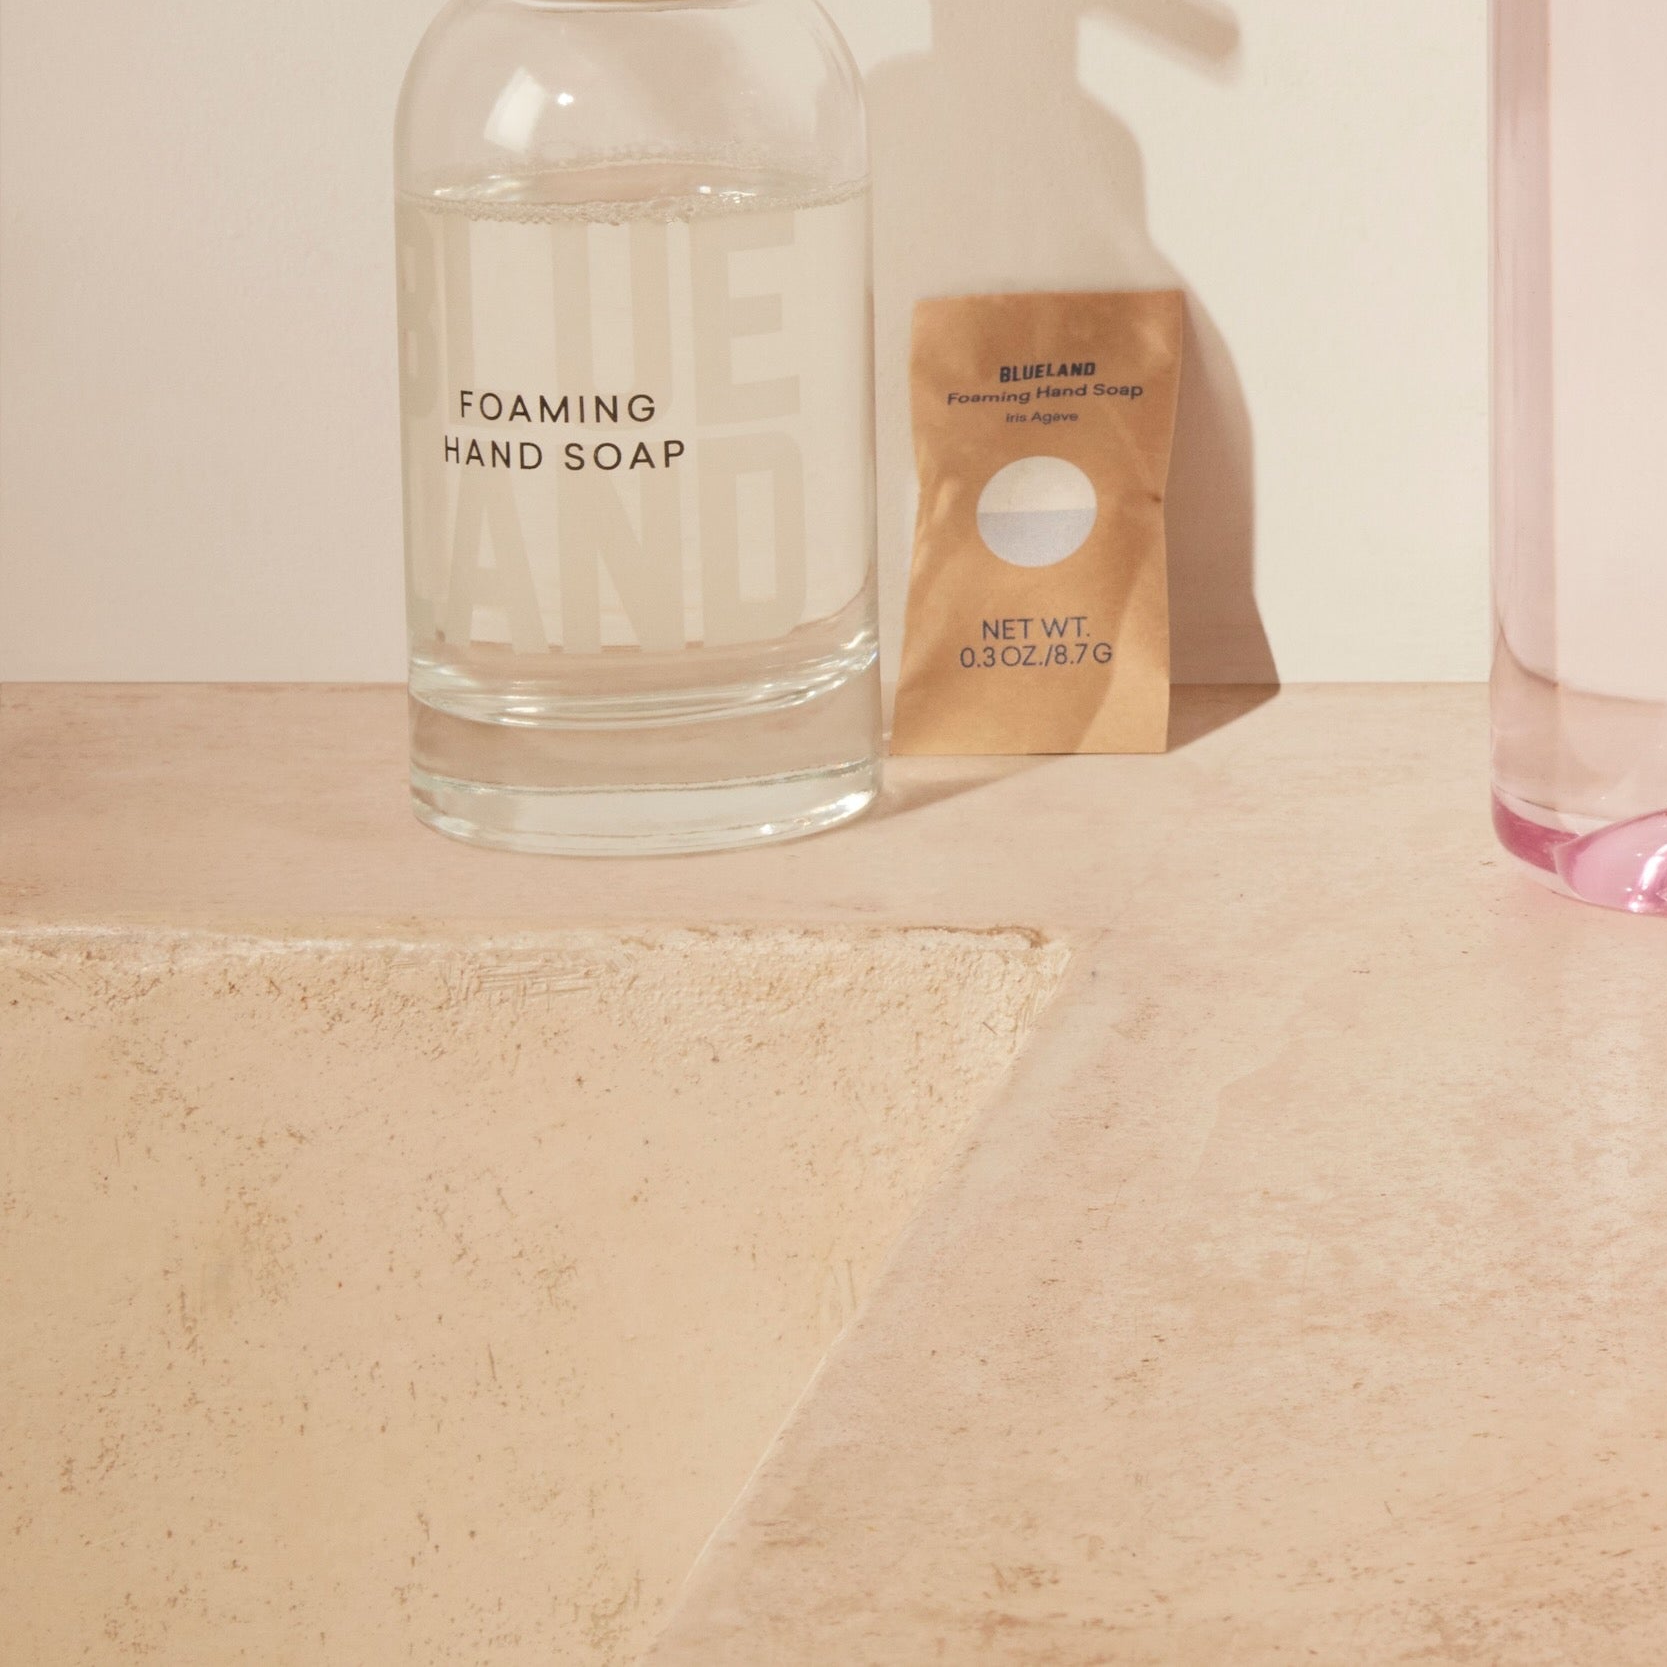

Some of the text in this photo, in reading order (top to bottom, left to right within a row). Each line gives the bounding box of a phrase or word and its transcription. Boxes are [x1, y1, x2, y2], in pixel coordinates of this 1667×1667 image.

[999, 362, 1096, 383] BLUELAND
[947, 383, 1144, 405] Foaming Hand Soap
[459, 390, 656, 423] FOAMING
[1005, 411, 1079, 425] Iris Agave
[445, 435, 685, 471] HAND SOAP
[981, 616, 1090, 640] NET WT.
[960, 642, 1113, 668] 0.3 OZ./8.7 G
